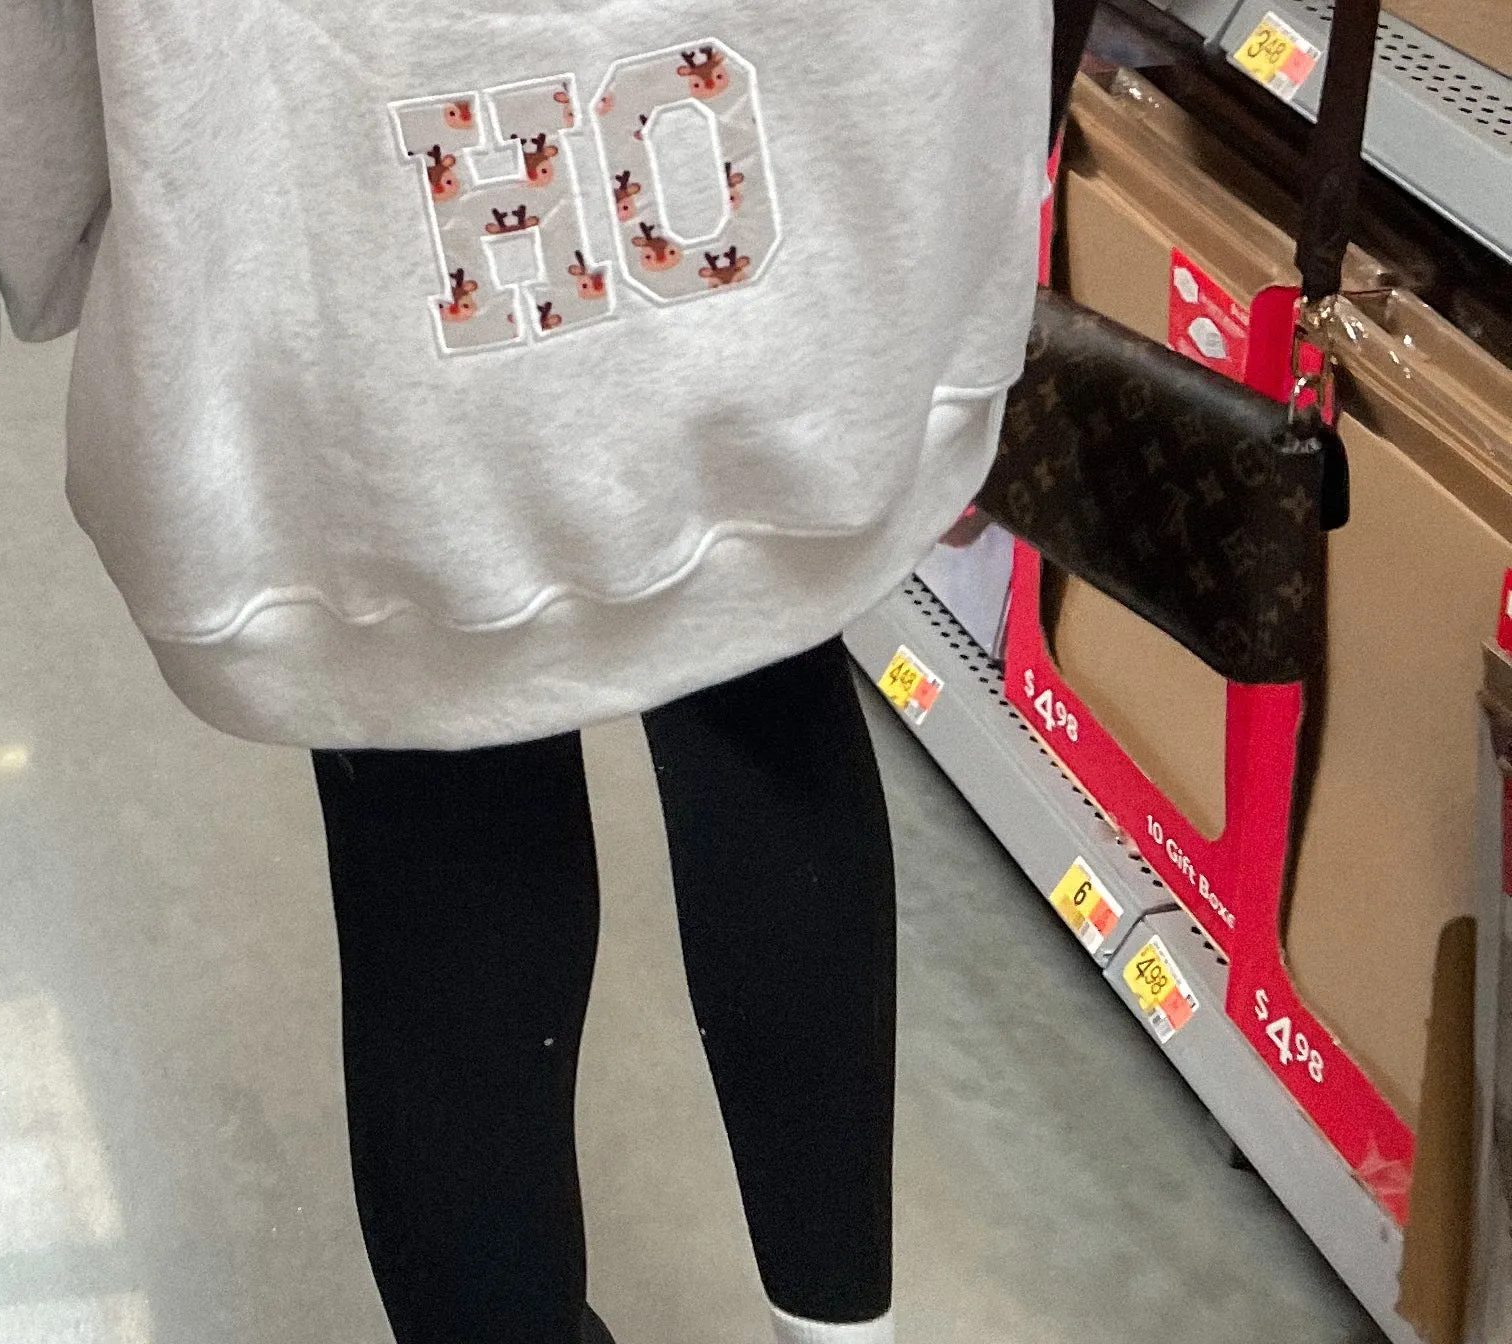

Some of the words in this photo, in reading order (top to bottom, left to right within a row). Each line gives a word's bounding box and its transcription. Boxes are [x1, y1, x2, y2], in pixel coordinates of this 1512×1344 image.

[389, 37, 783, 356] HO
[1146, 814, 1164, 845] 10
[1165, 838, 1197, 886] Gift
